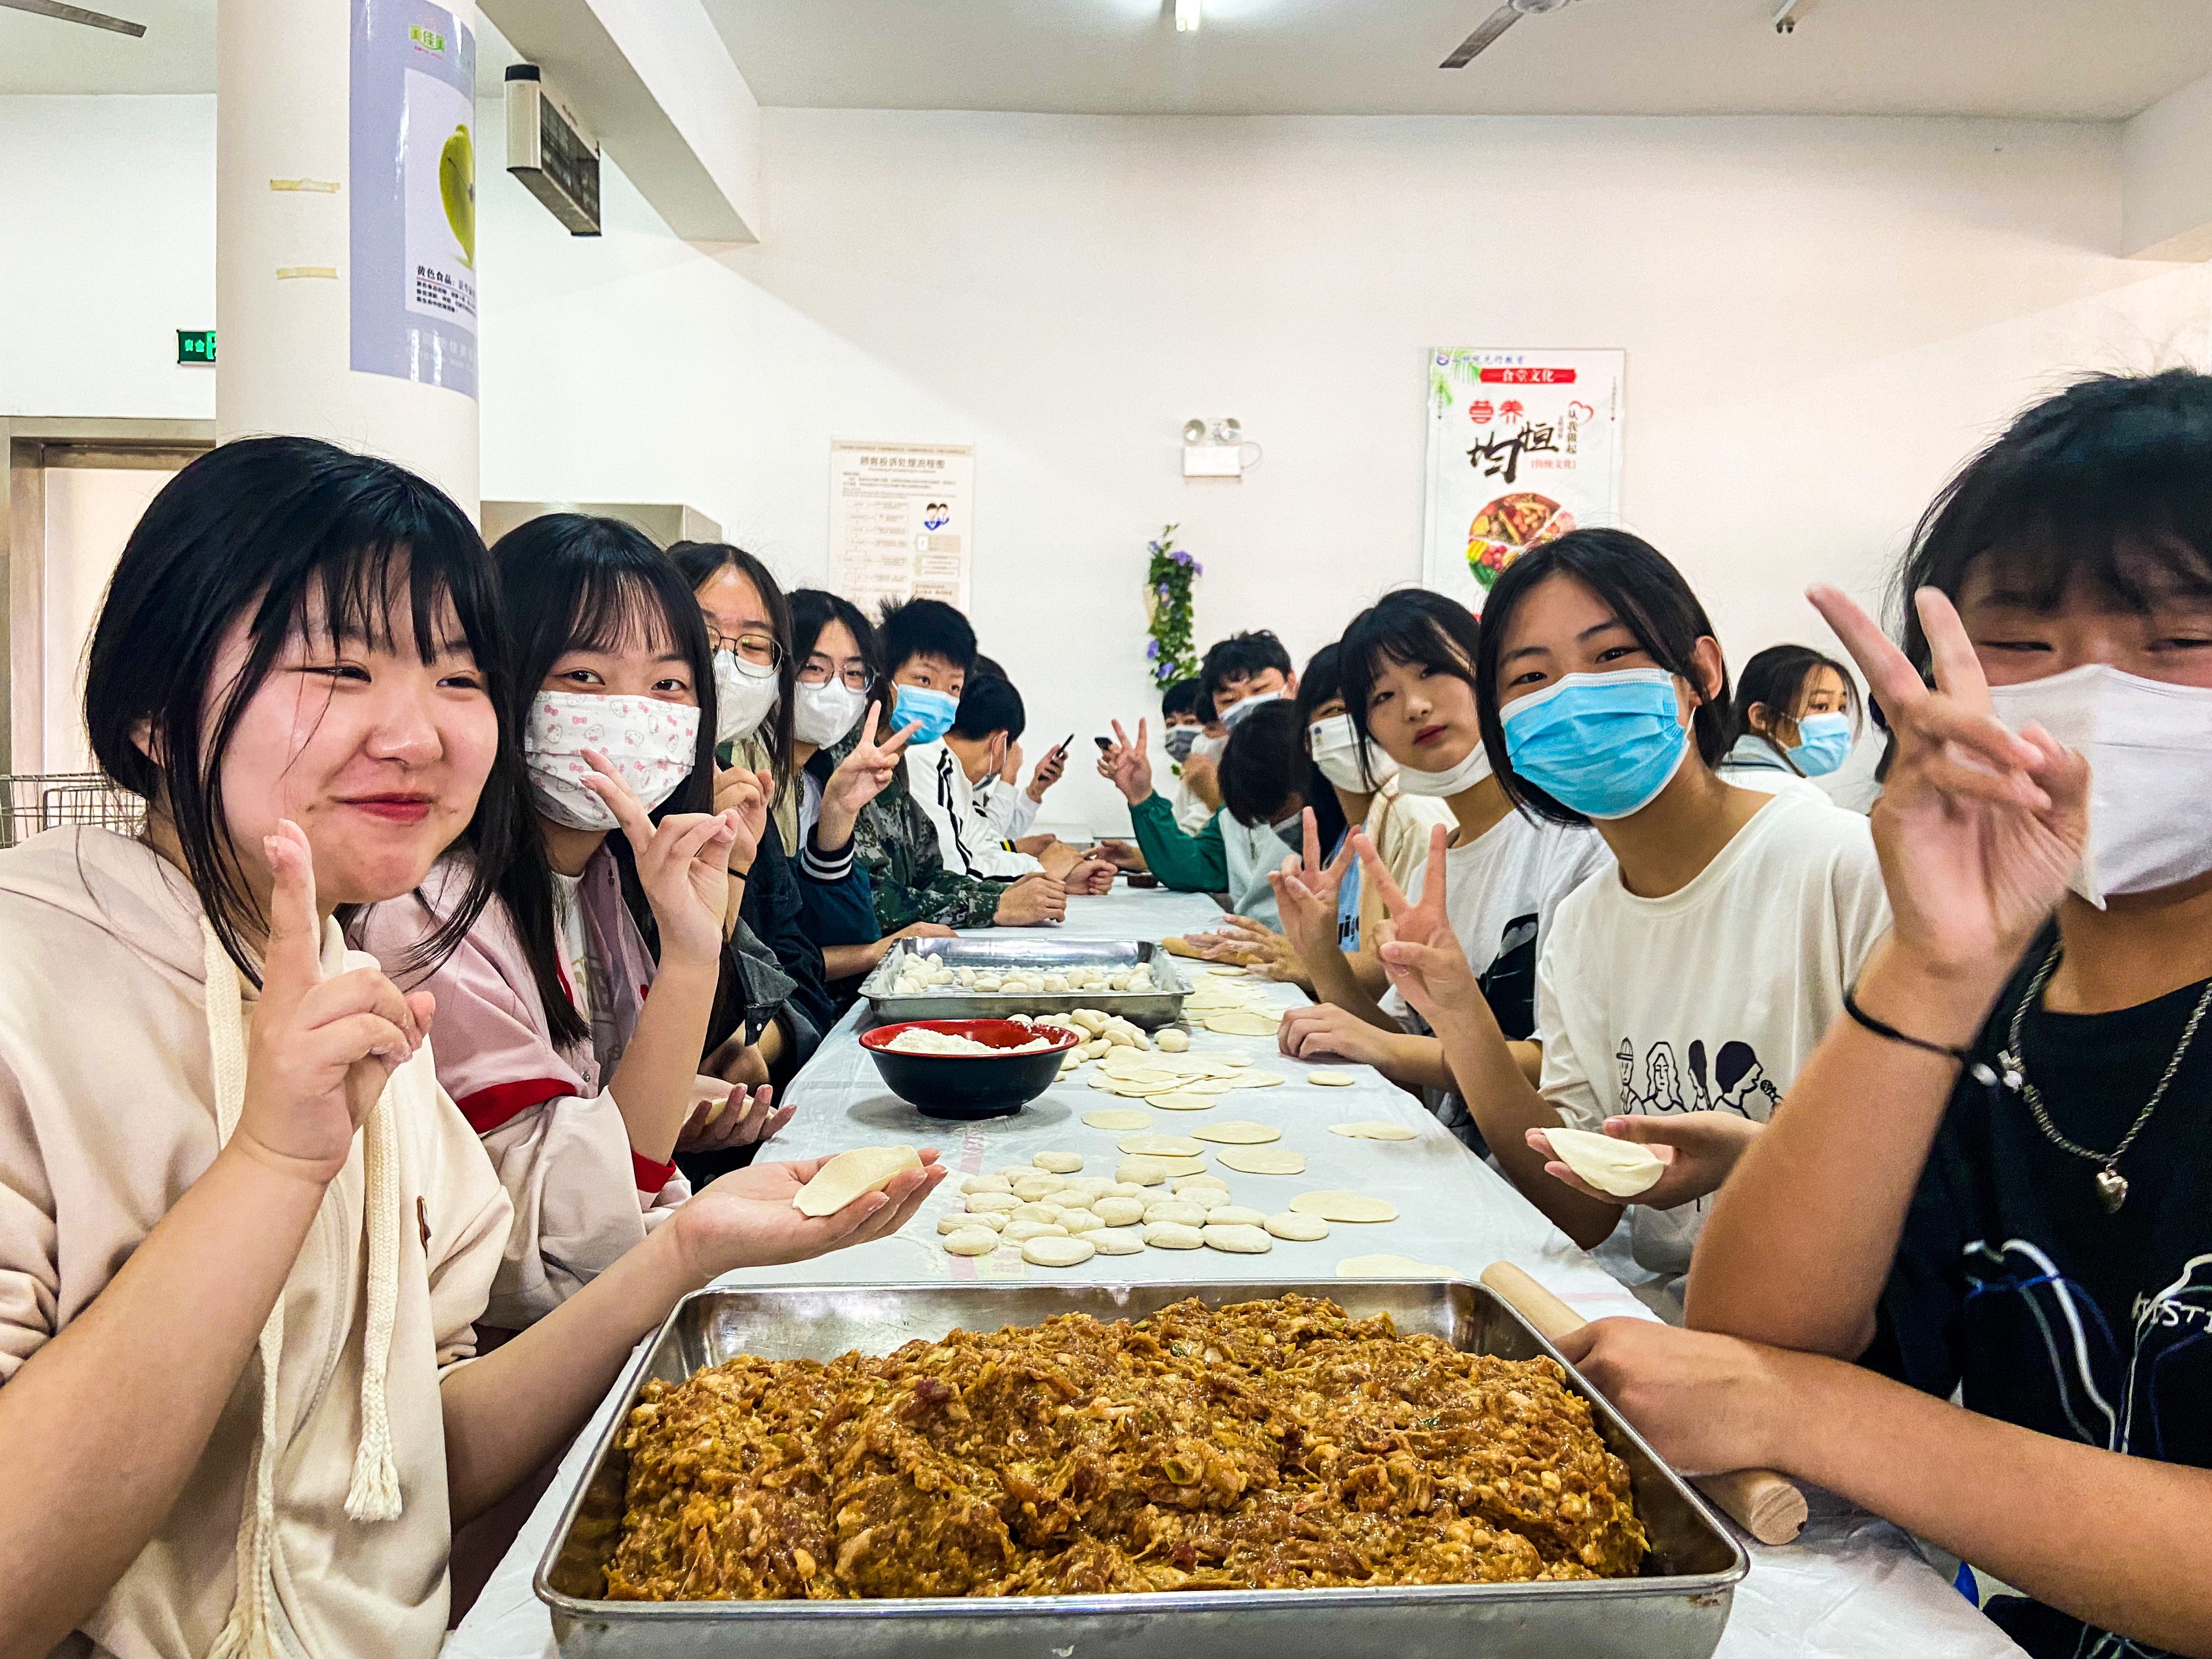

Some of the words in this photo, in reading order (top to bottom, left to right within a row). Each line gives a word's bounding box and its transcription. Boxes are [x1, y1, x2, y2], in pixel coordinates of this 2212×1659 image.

[1502, 369, 1554, 382] 食堂文化
[1470, 400, 1523, 425] 营养
